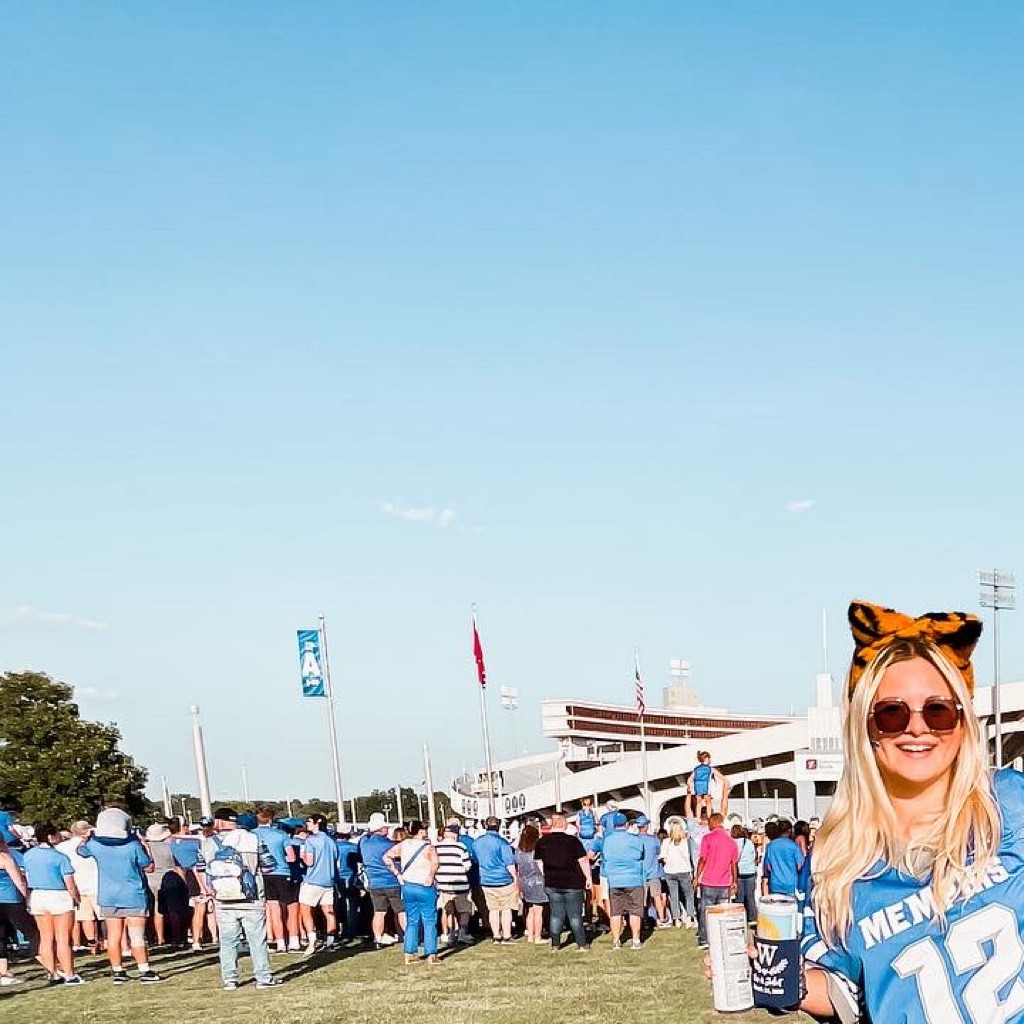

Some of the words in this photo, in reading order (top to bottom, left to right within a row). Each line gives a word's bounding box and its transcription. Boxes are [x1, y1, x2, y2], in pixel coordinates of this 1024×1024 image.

[302, 652, 320, 678] A
[858, 857, 1009, 950] MEMIS
[756, 942, 778, 966] W
